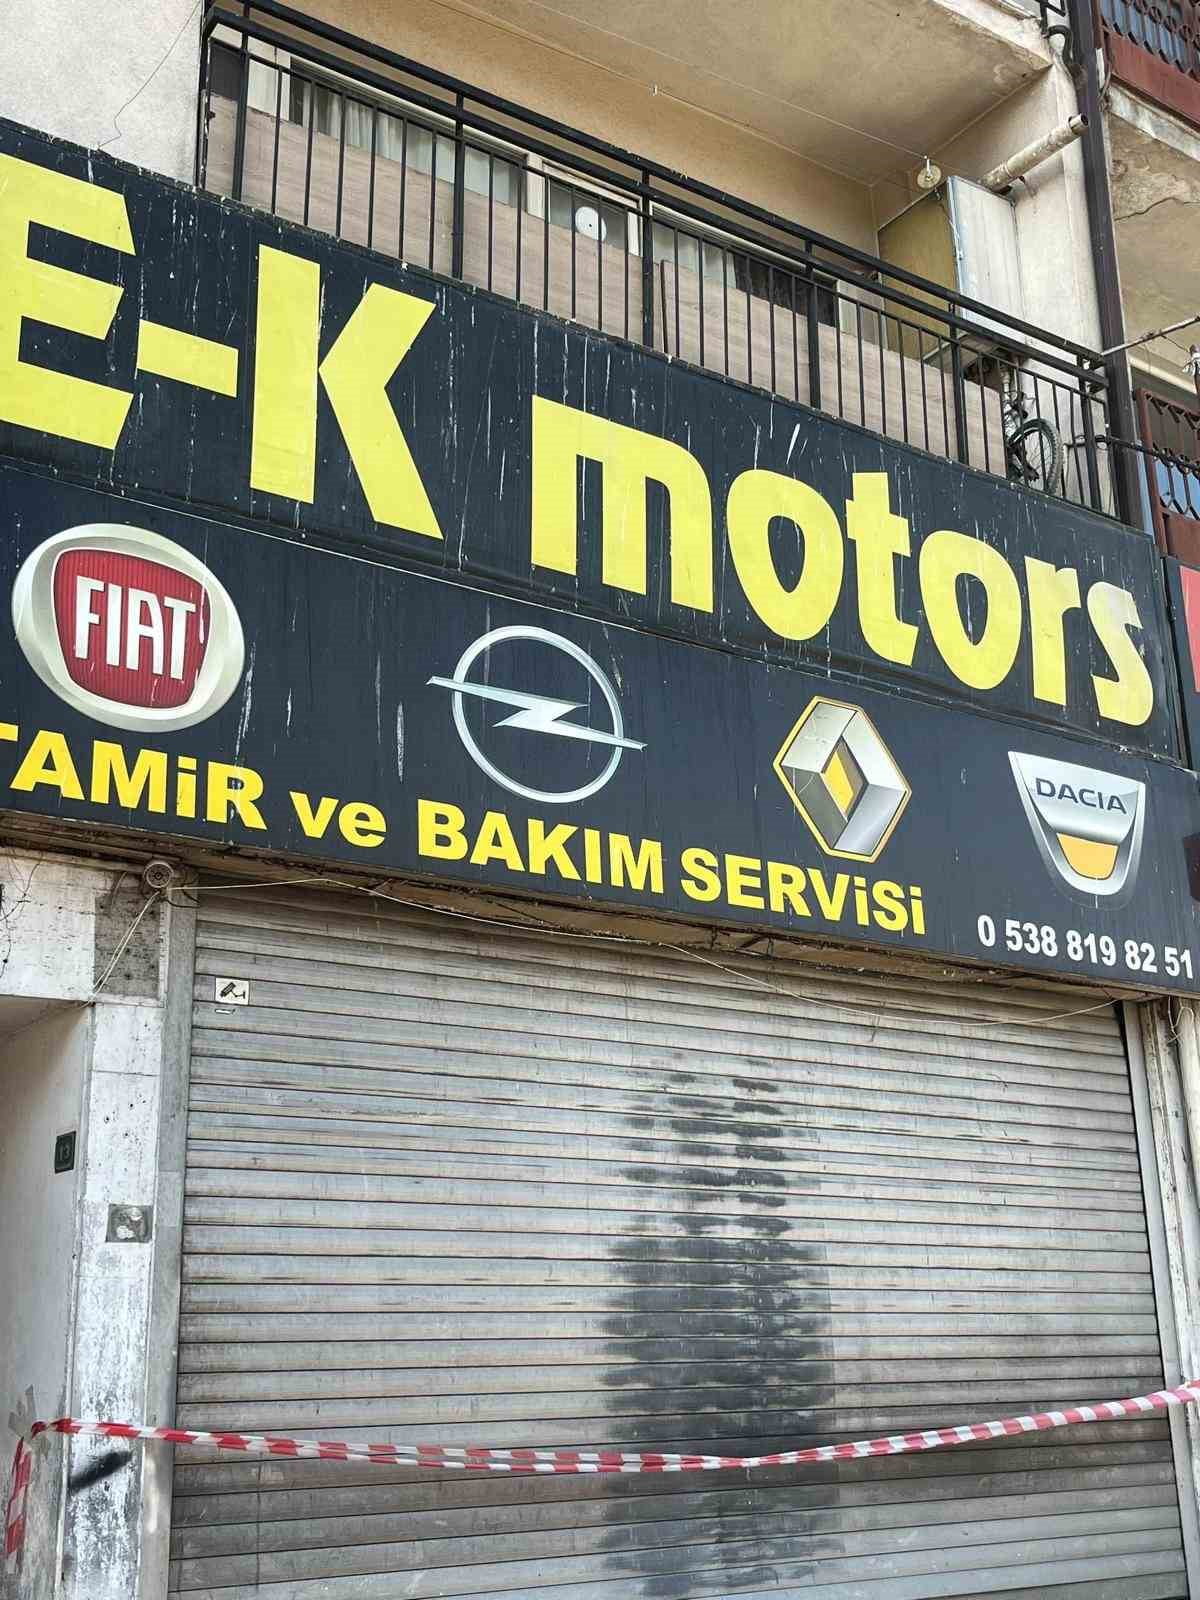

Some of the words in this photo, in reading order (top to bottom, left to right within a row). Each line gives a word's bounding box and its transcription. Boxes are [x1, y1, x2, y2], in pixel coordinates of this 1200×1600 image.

[0, 152, 444, 540] E-K
[531, 394, 1154, 727] motors
[74, 575, 196, 680] FIAT
[290, 790, 387, 848] ve
[418, 799, 664, 893] BAKIM
[1035, 777, 1127, 814] DACIA
[977, 915, 996, 948] 0
[1005, 919, 1058, 957] 538
[1066, 930, 1116, 966] 819
[1124, 940, 1158, 973] 82
[1164, 946, 1193, 979] 51
